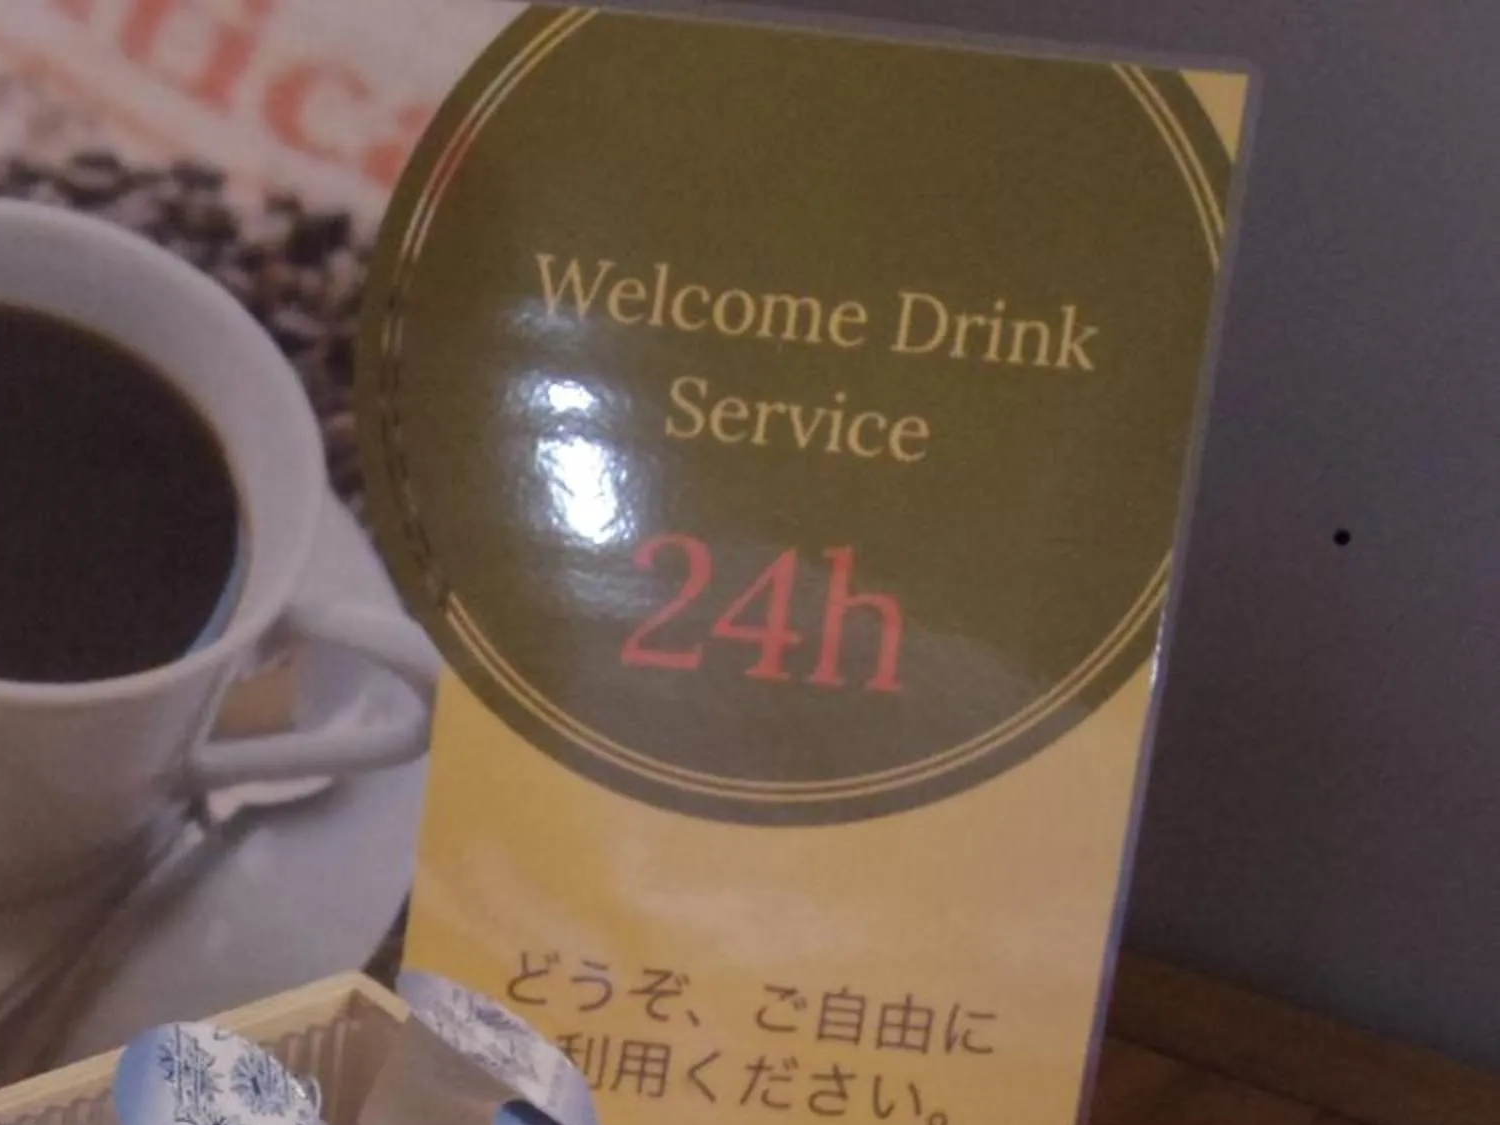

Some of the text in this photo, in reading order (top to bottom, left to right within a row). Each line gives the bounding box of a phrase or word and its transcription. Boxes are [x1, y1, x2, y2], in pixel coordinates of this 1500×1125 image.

[535, 254, 1100, 371] Welcome Drink
[664, 376, 931, 462] Service
[620, 532, 905, 693] 24h
[505, 950, 998, 1056] どうぞ、ご自由に
